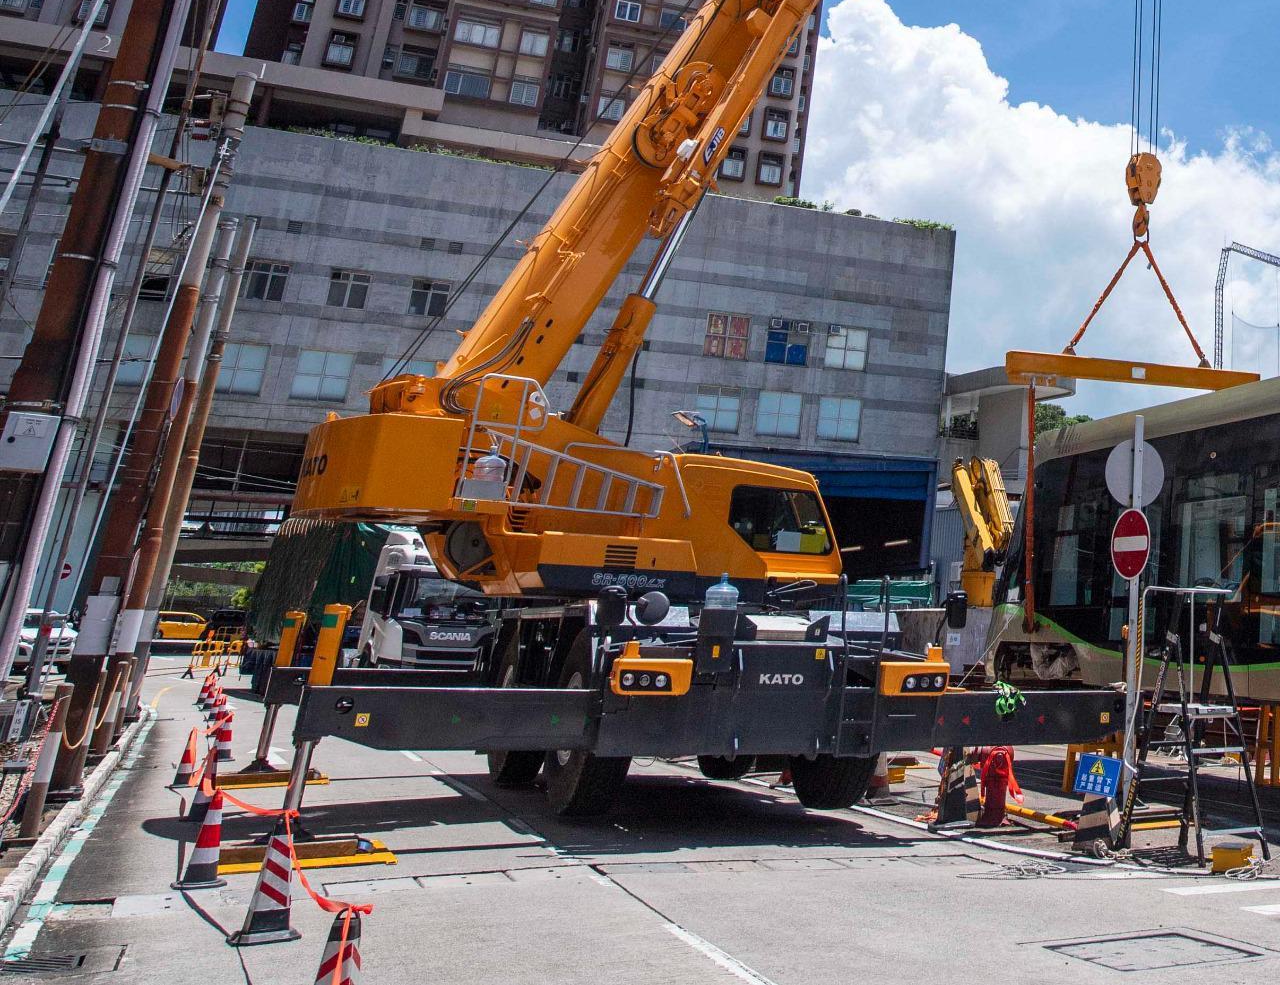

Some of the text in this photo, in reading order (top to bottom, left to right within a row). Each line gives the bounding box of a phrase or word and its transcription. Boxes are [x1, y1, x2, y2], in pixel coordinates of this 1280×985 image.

[97, 35, 112, 53] 2
[429, 631, 472, 642] SCANIA
[759, 673, 804, 685] KATO
